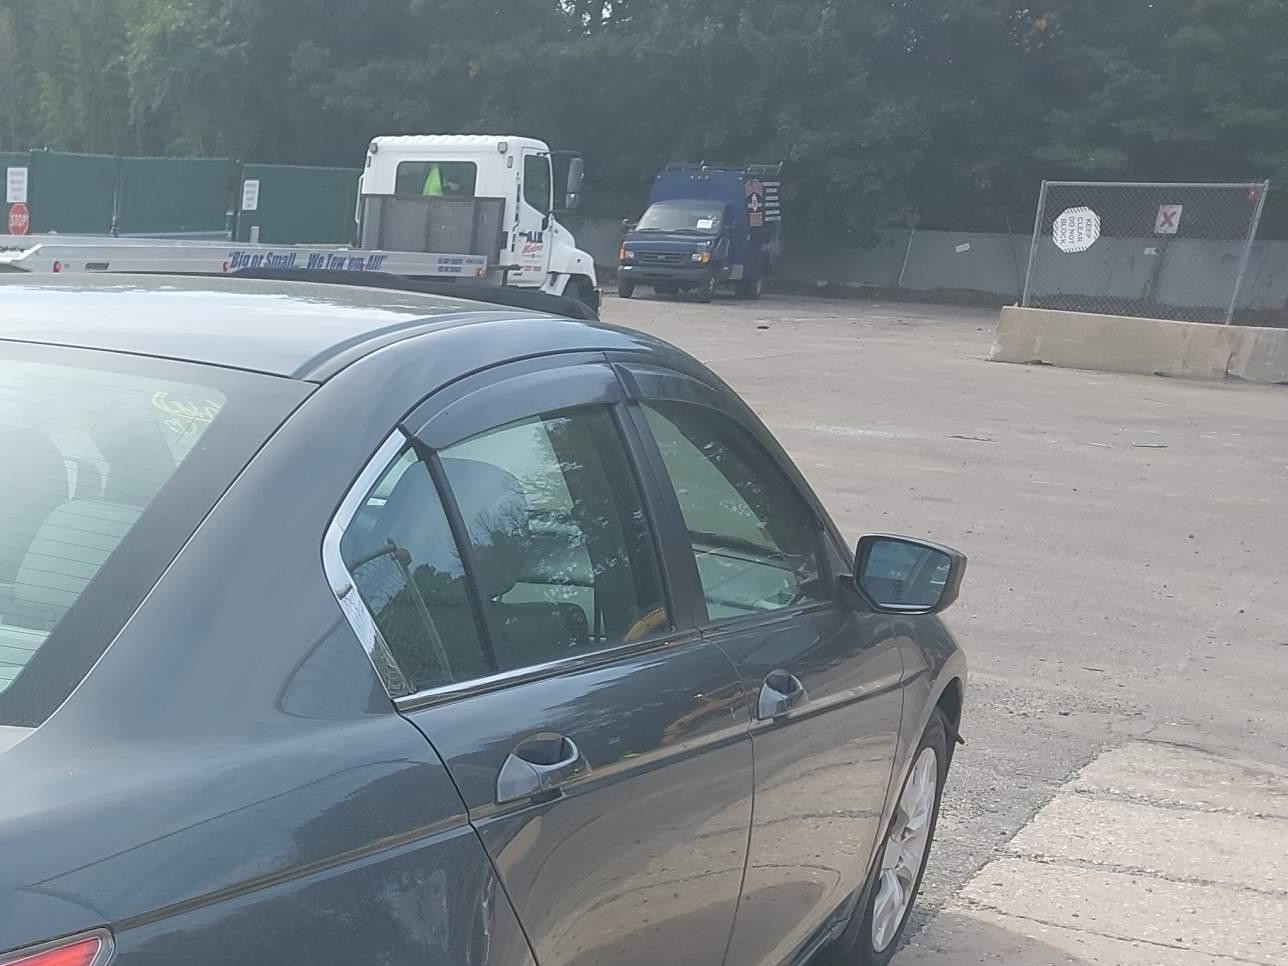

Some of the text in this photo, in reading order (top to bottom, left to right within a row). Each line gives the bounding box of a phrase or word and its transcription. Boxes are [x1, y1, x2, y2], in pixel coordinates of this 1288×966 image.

[10, 213, 28, 227] STOP
[250, 254, 264, 267] or
[307, 253, 324, 270] We
[326, 253, 347, 270] Tow
